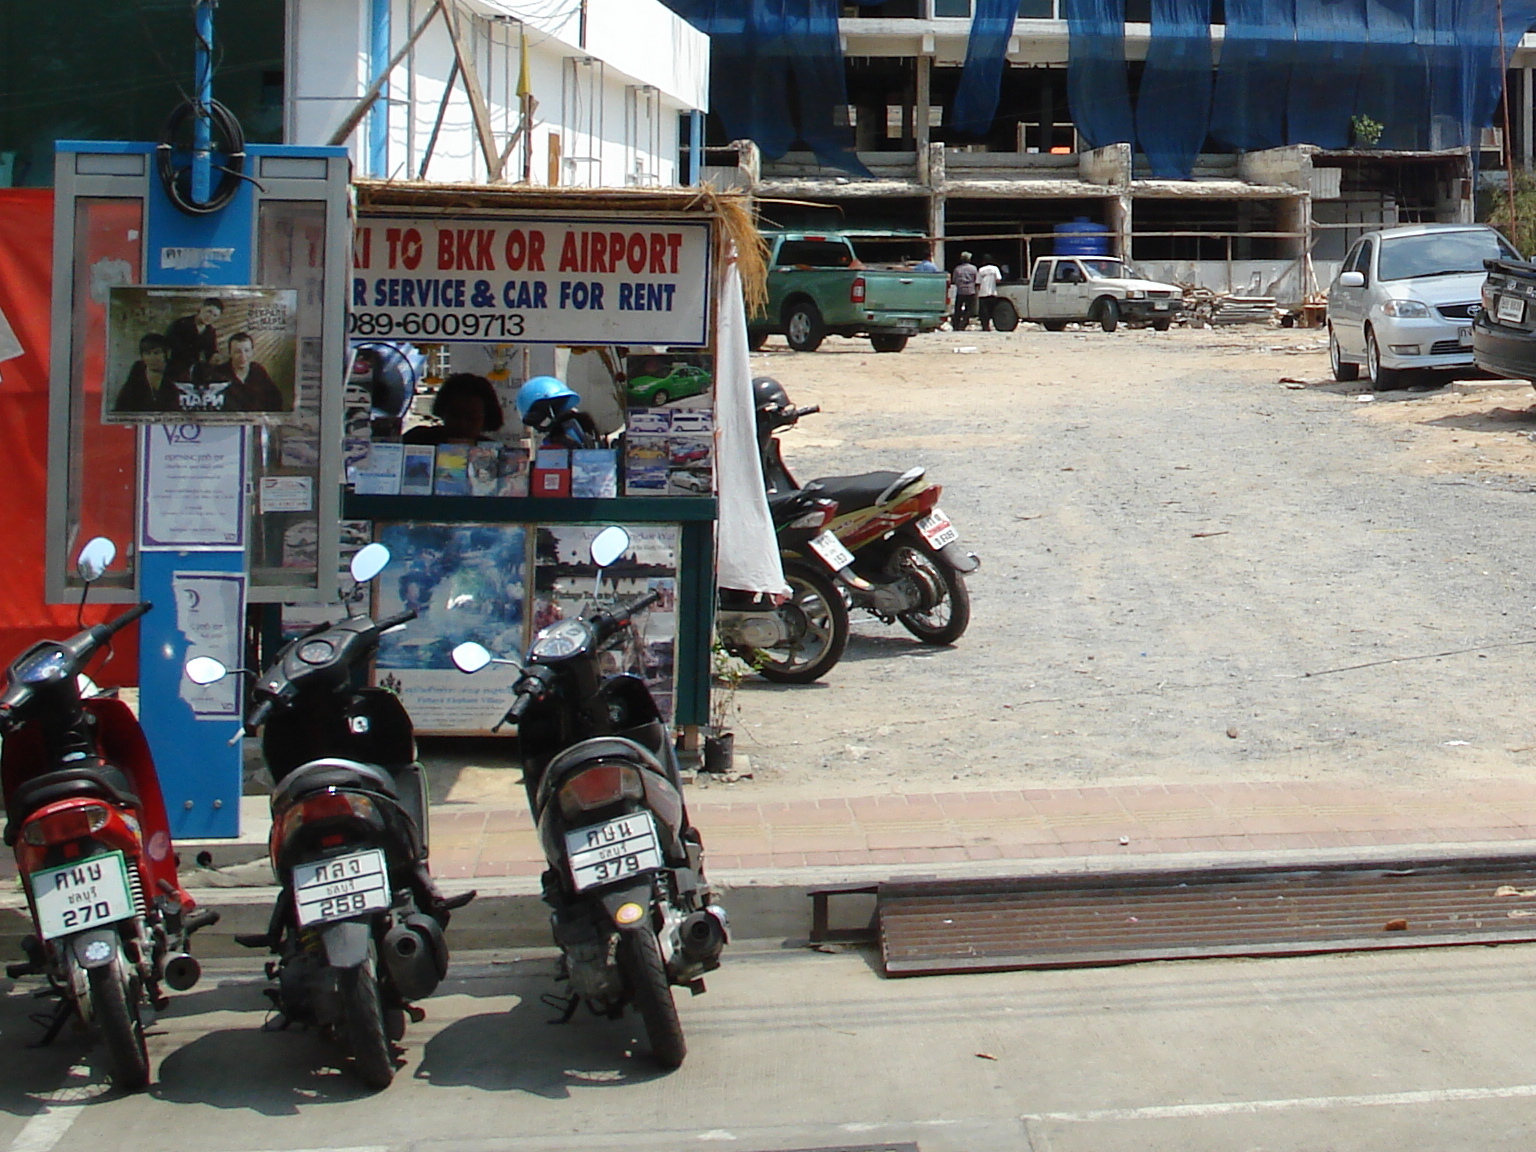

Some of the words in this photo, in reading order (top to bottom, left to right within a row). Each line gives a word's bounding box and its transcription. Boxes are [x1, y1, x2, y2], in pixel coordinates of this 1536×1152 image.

[386, 228, 423, 270] TO
[437, 229, 496, 271] BKK
[505, 229, 546, 271] OR
[558, 231, 683, 274] AIRPORT
[374, 278, 466, 308] SERVICE
[470, 279, 496, 308] &
[503, 280, 547, 309] CAR
[559, 281, 604, 310] FOR
[619, 282, 676, 312] RENT
[595, 855, 639, 880] 379
[62, 901, 110, 927] 270
[320, 893, 366, 917] 258
